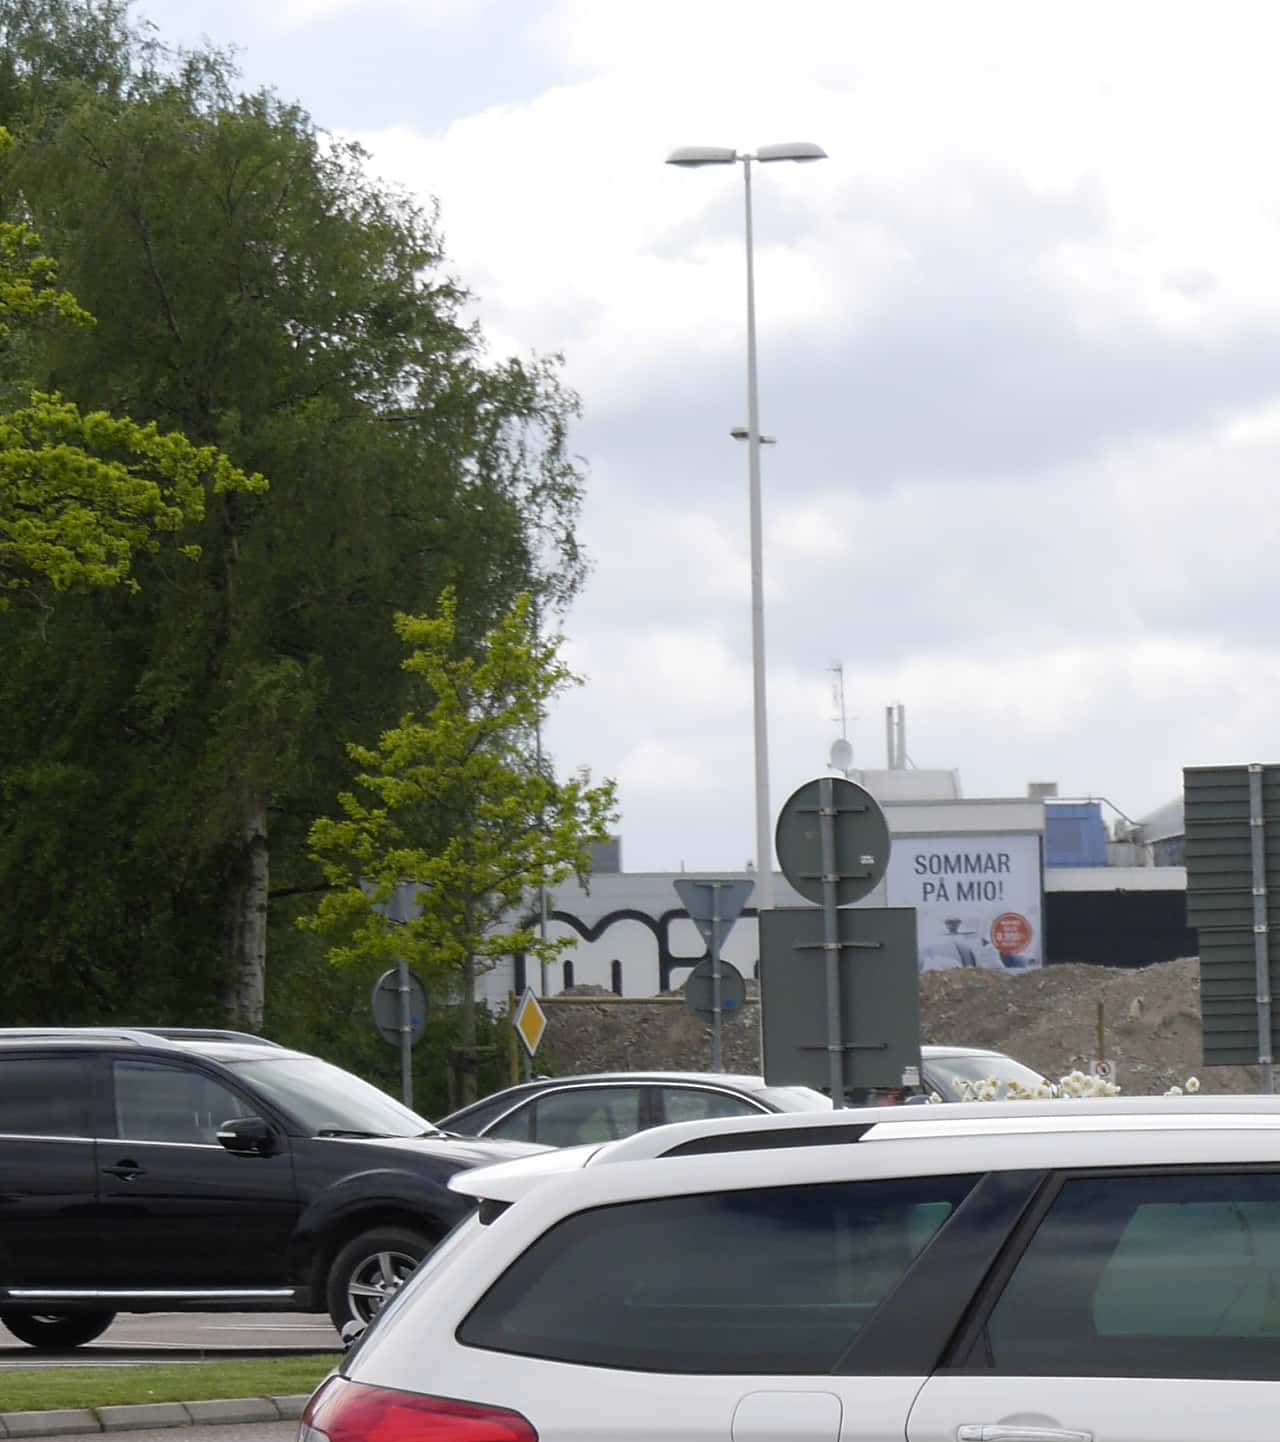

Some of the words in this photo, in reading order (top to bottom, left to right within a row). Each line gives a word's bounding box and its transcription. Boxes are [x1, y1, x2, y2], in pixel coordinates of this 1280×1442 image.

[914, 853, 1011, 875] SOMMAR
[922, 876, 950, 902] PÅ
[956, 880, 1003, 902] MIO!
